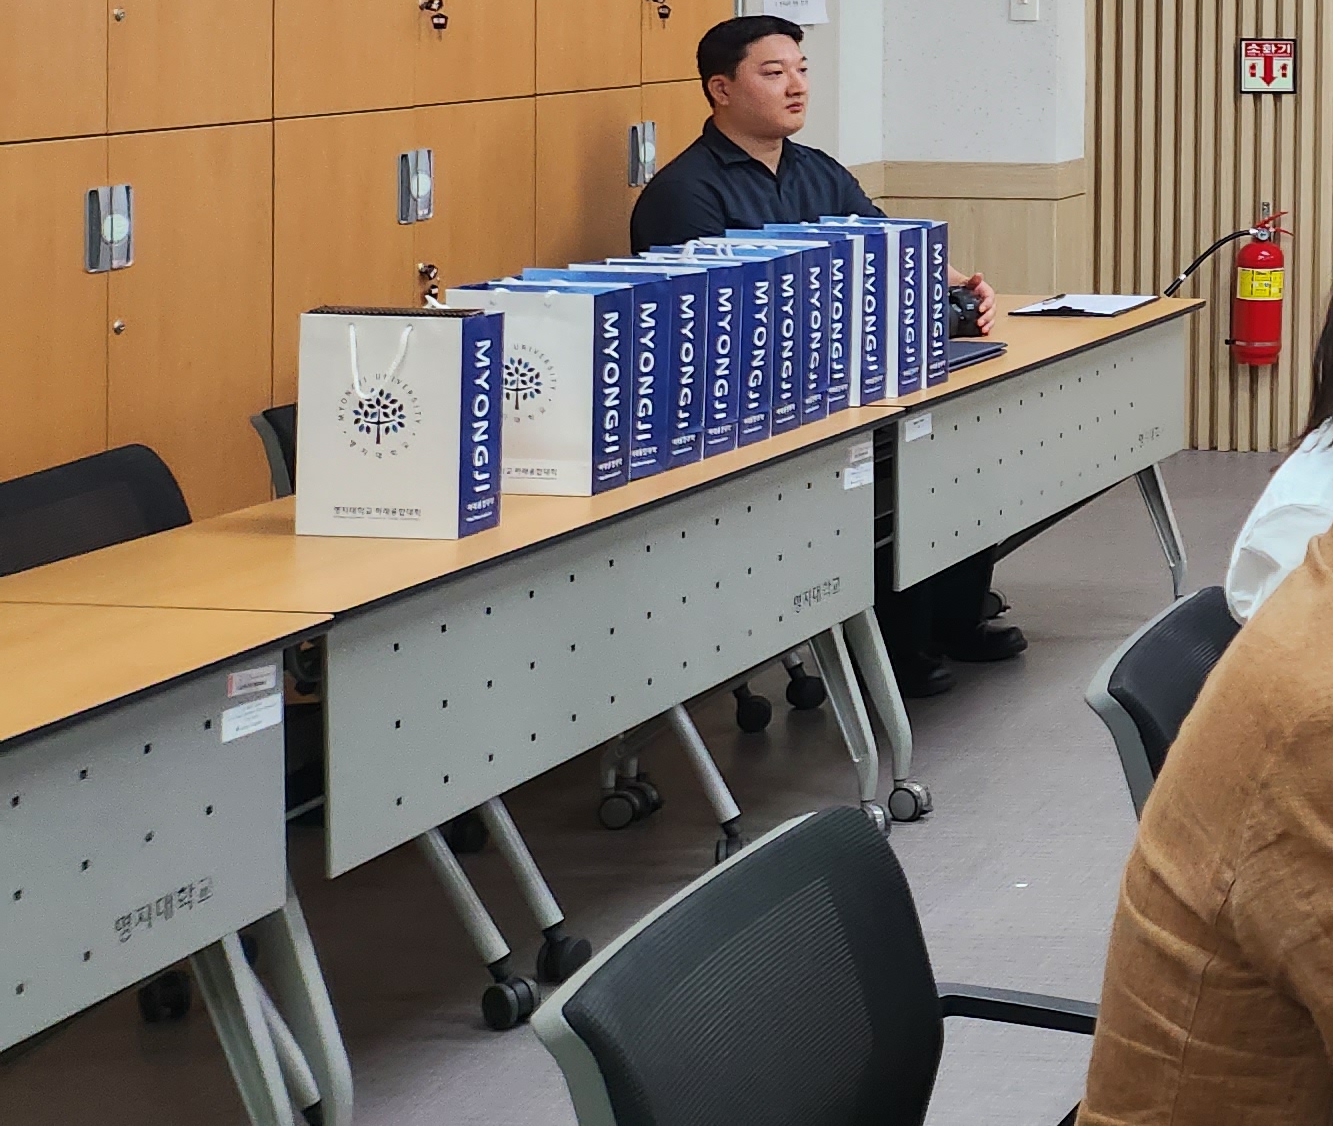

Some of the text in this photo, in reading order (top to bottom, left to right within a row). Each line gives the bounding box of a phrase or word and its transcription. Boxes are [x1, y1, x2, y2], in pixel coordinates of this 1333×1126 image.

[1246, 43, 1291, 54] 소화기
[678, 294, 695, 429] MYONGJI
[713, 287, 733, 420] MYONGJI
[747, 281, 770, 410] MYONGJI
[780, 273, 794, 400] MYONGJI
[808, 266, 821, 390] MYONGJI
[831, 258, 845, 379] MYONGJI
[864, 253, 879, 371] MYONGJI
[904, 247, 916, 363] MYONGJI
[932, 243, 944, 357] MYONGJI
[472, 339, 492, 493] MYONGJI
[602, 311, 620, 454] MYONGJI
[635, 302, 657, 441] MYONGJI
[114, 876, 214, 944] 명지대학교
